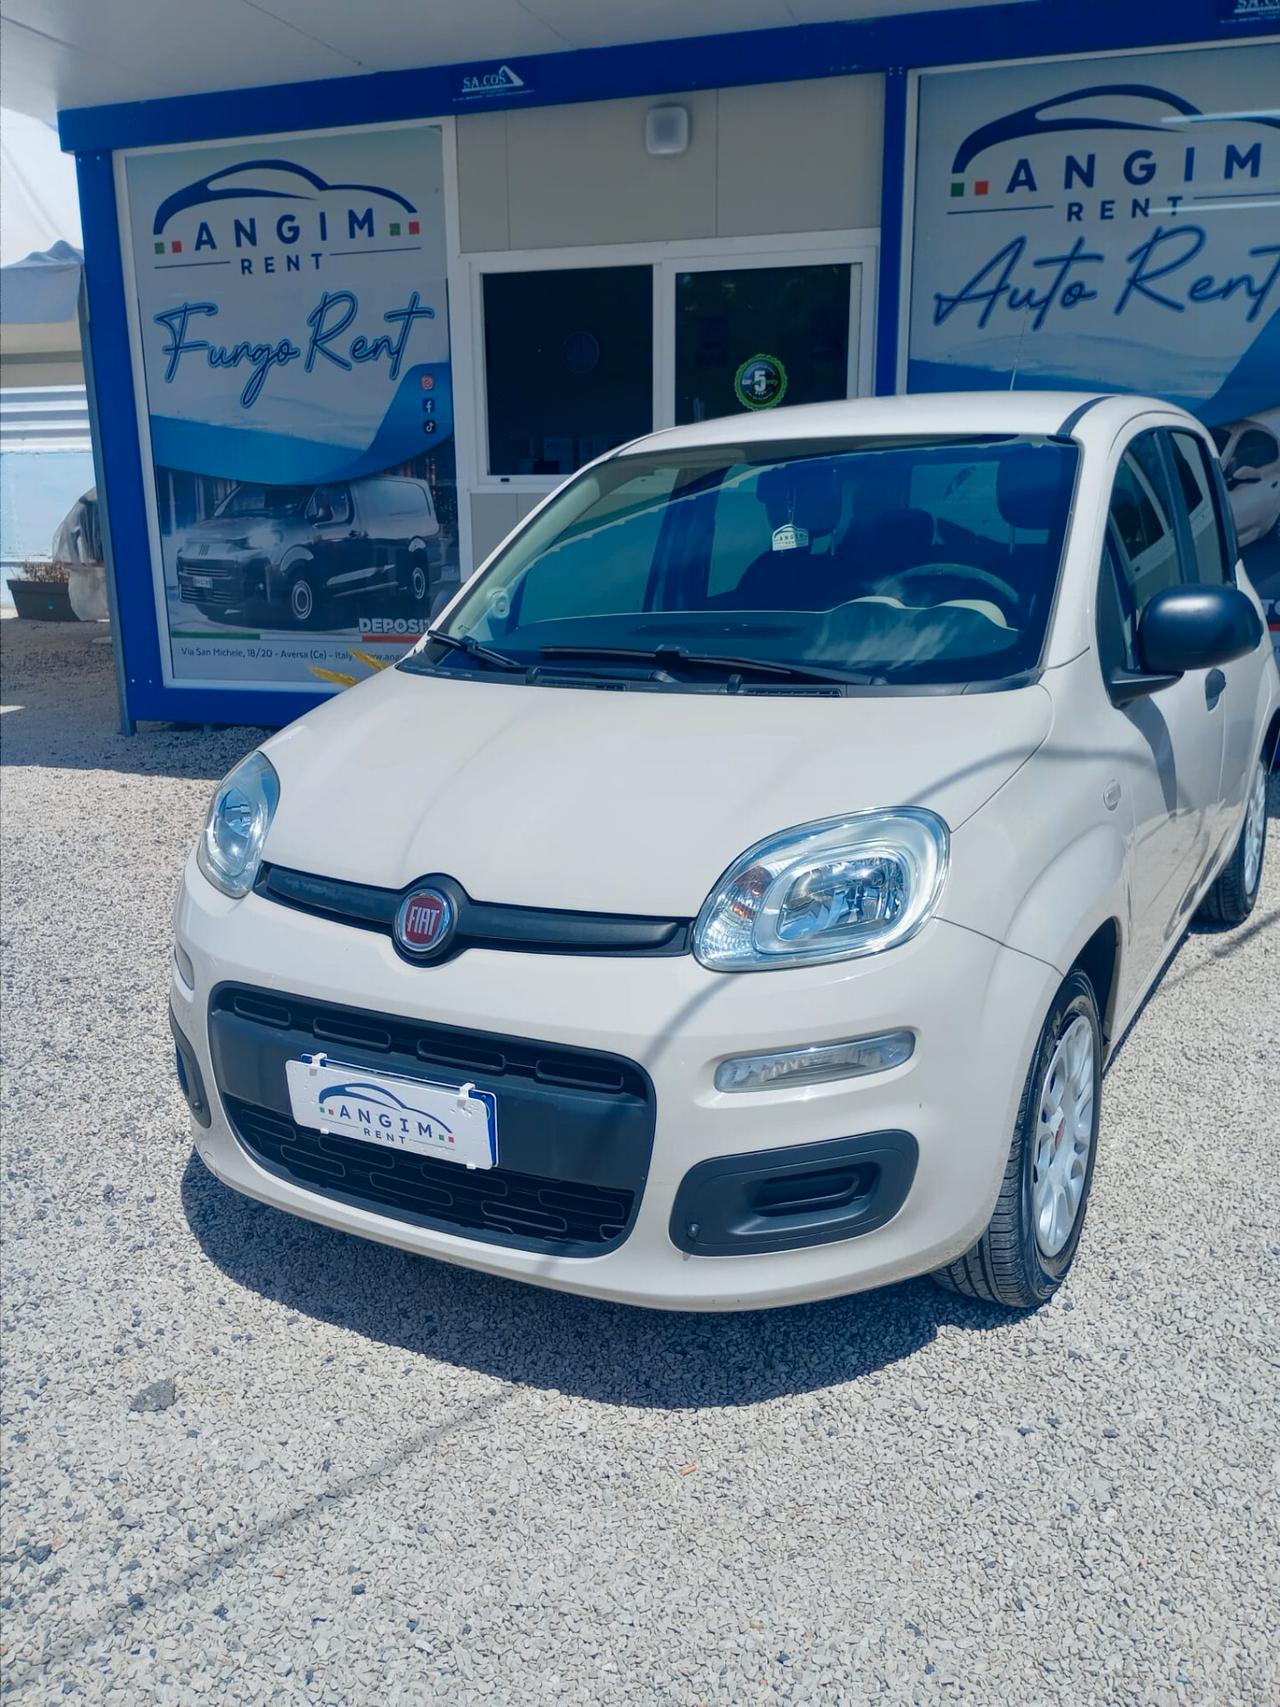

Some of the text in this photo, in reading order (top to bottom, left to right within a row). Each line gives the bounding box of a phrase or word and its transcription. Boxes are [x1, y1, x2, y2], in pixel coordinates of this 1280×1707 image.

[1005, 143, 1262, 193] ANGIM
[1066, 196, 1183, 223] RENT
[194, 208, 375, 250] ANGIM
[240, 253, 323, 275] RENT
[933, 225, 1280, 330] Auto Rent
[154, 290, 435, 408] Fungo Rent
[181, 647, 194, 657] Via
[195, 648, 211, 657] San
[213, 648, 246, 660] Michele,
[247, 648, 273, 659] 18/20
[281, 649, 309, 659] Aversa
[310, 649, 327, 660] (Ce)
[335, 650, 352, 661] Italy
[407, 905, 440, 935] FIAT
[339, 1105, 432, 1138] ANGIM
[363, 1128, 406, 1145] RENT
